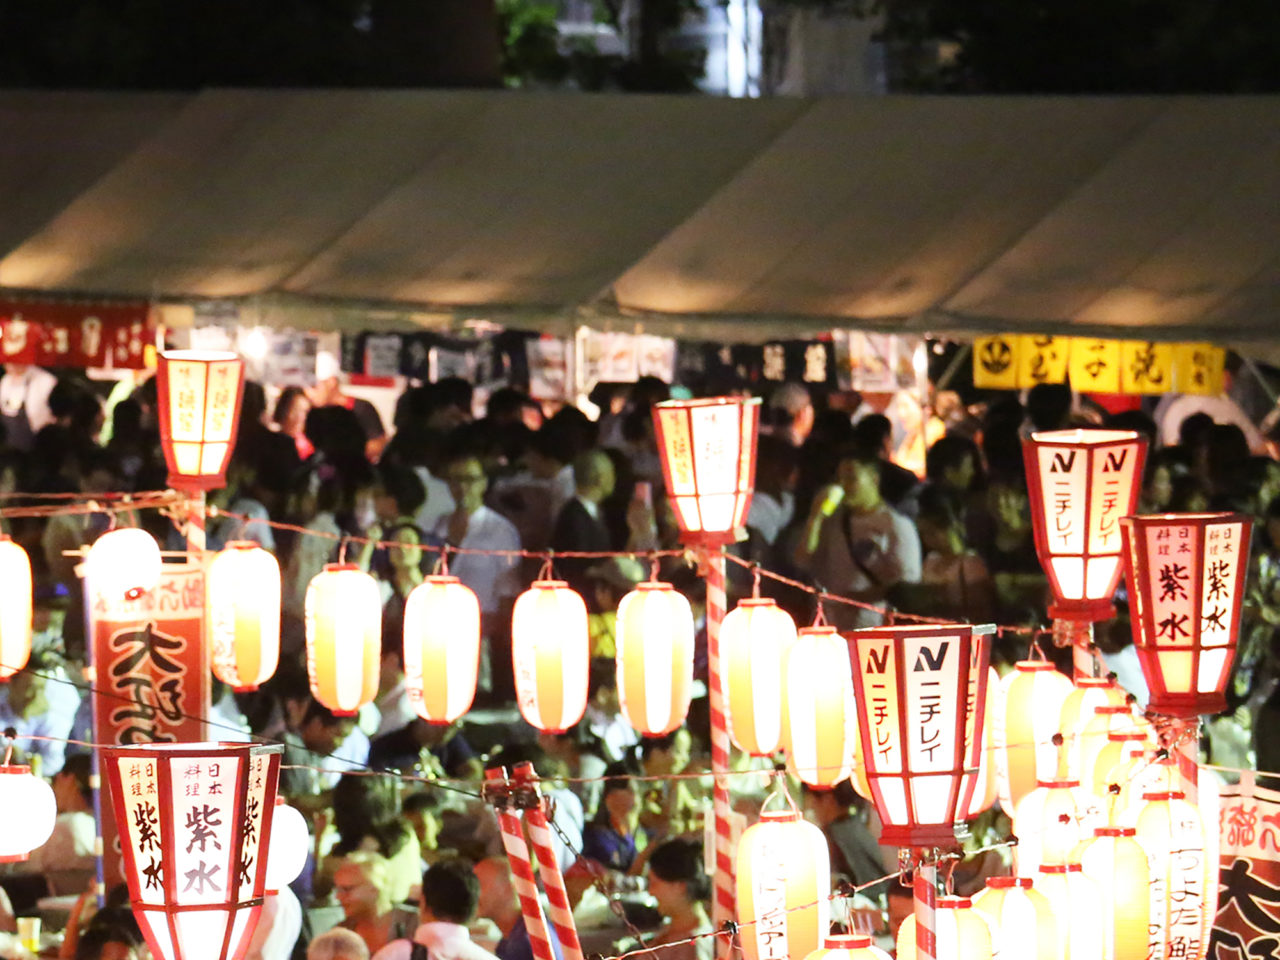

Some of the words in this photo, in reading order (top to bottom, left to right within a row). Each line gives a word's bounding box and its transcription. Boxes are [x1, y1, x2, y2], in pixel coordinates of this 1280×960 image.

[1054, 481, 1073, 546] ニチレイ
[1099, 480, 1119, 546] ニチレイ
[1155, 562, 1191, 641] 紫水
[1201, 559, 1229, 632] 紫水
[872, 684, 892, 764] ニチレイ
[920, 681, 941, 762] ニチレイ
[133, 800, 164, 891] 紫水
[184, 804, 222, 895] 紫水
